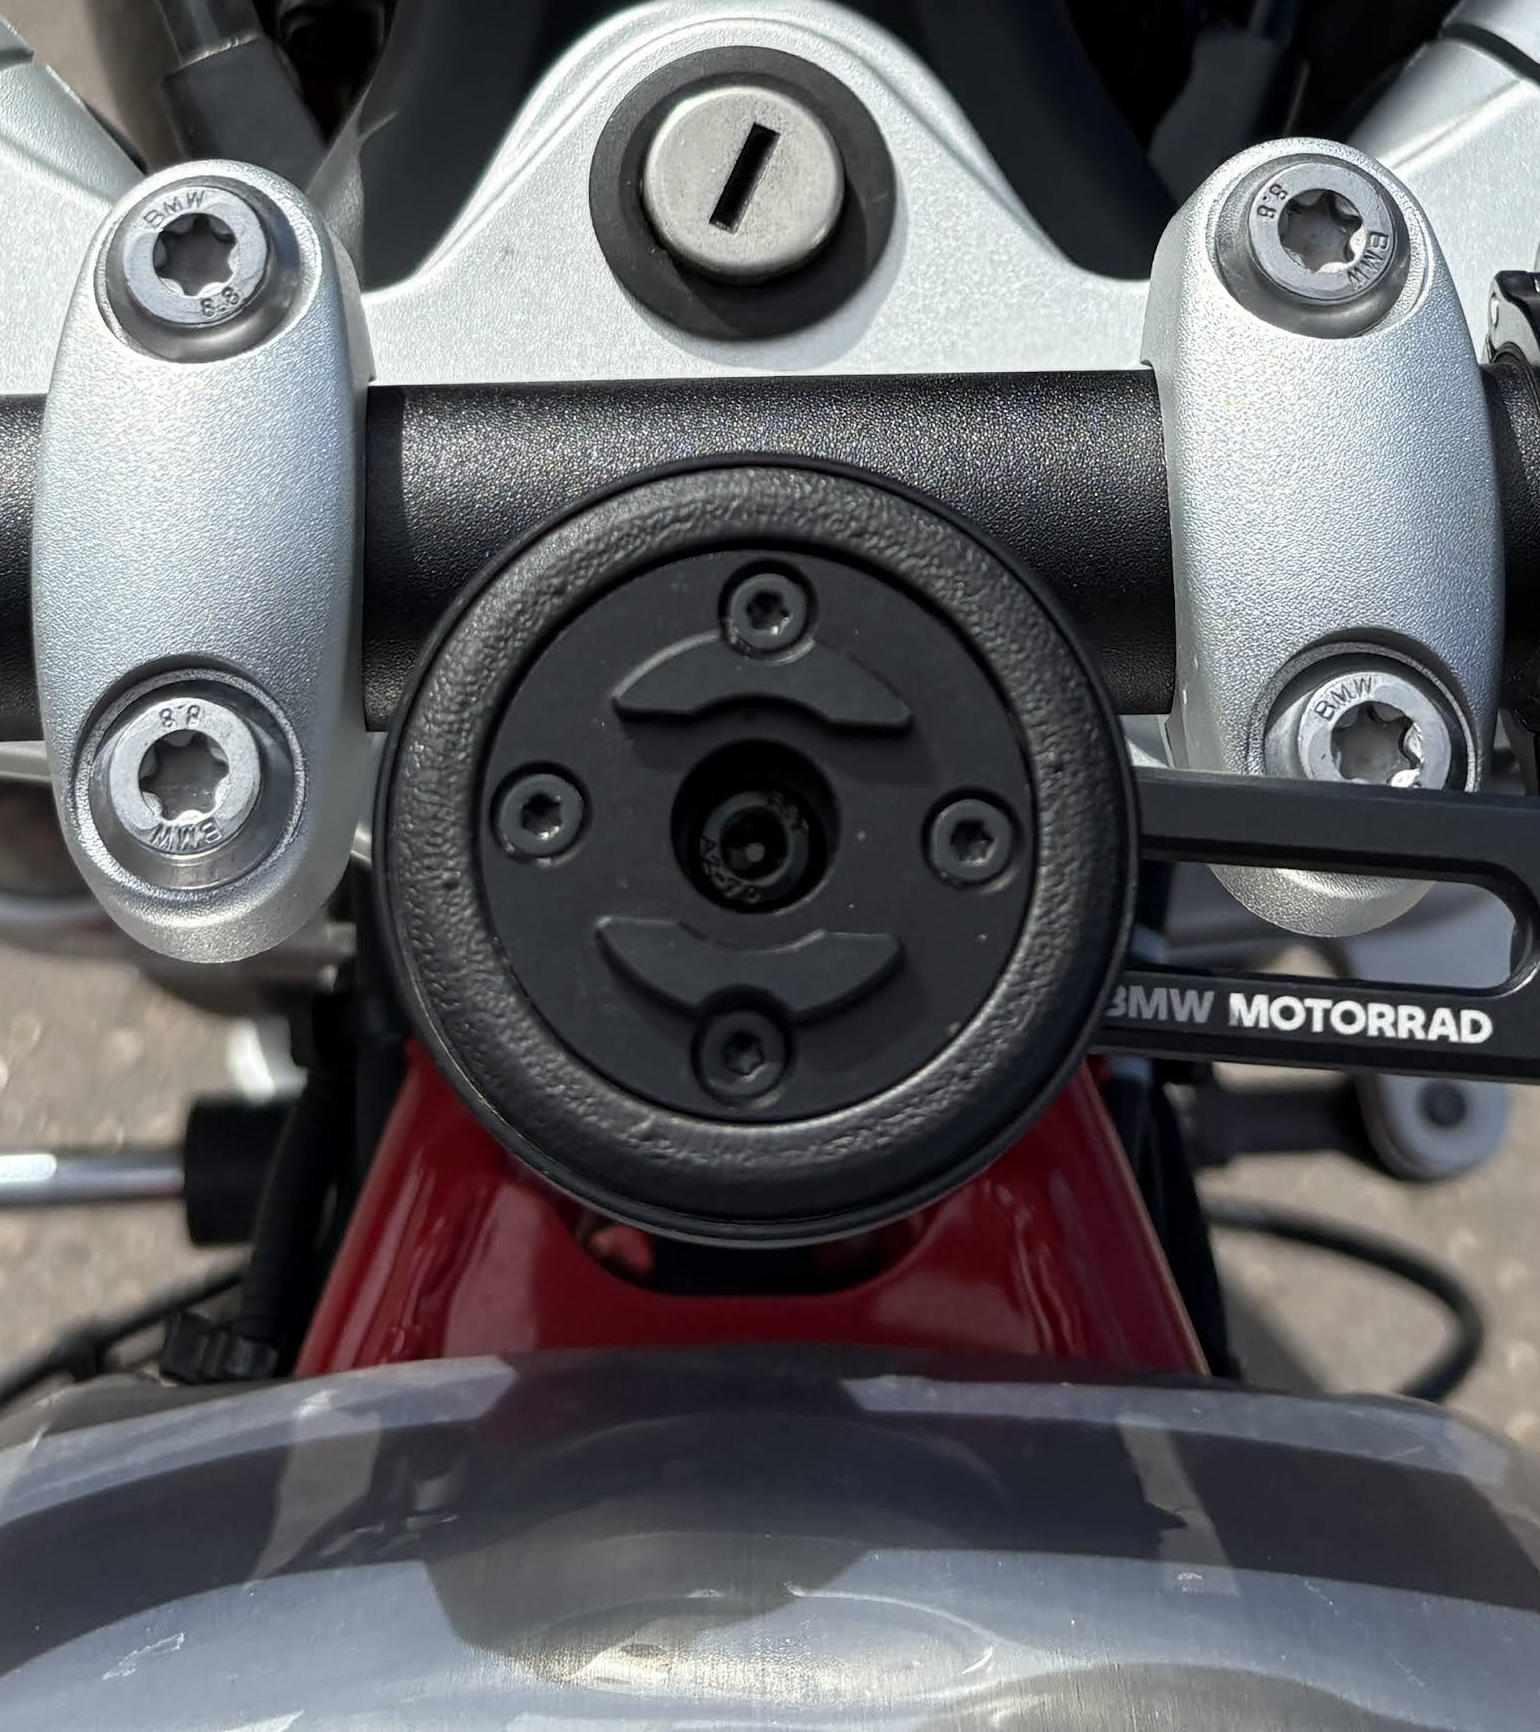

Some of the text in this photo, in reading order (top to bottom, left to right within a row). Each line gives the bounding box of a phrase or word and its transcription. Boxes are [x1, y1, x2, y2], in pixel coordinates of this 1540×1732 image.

[143, 190, 205, 229] BMW
[1346, 231, 1391, 291] BMW
[1313, 676, 1375, 722] BMW
[149, 819, 223, 852] BMW
[1228, 992, 1494, 1045] MOTORRAD
